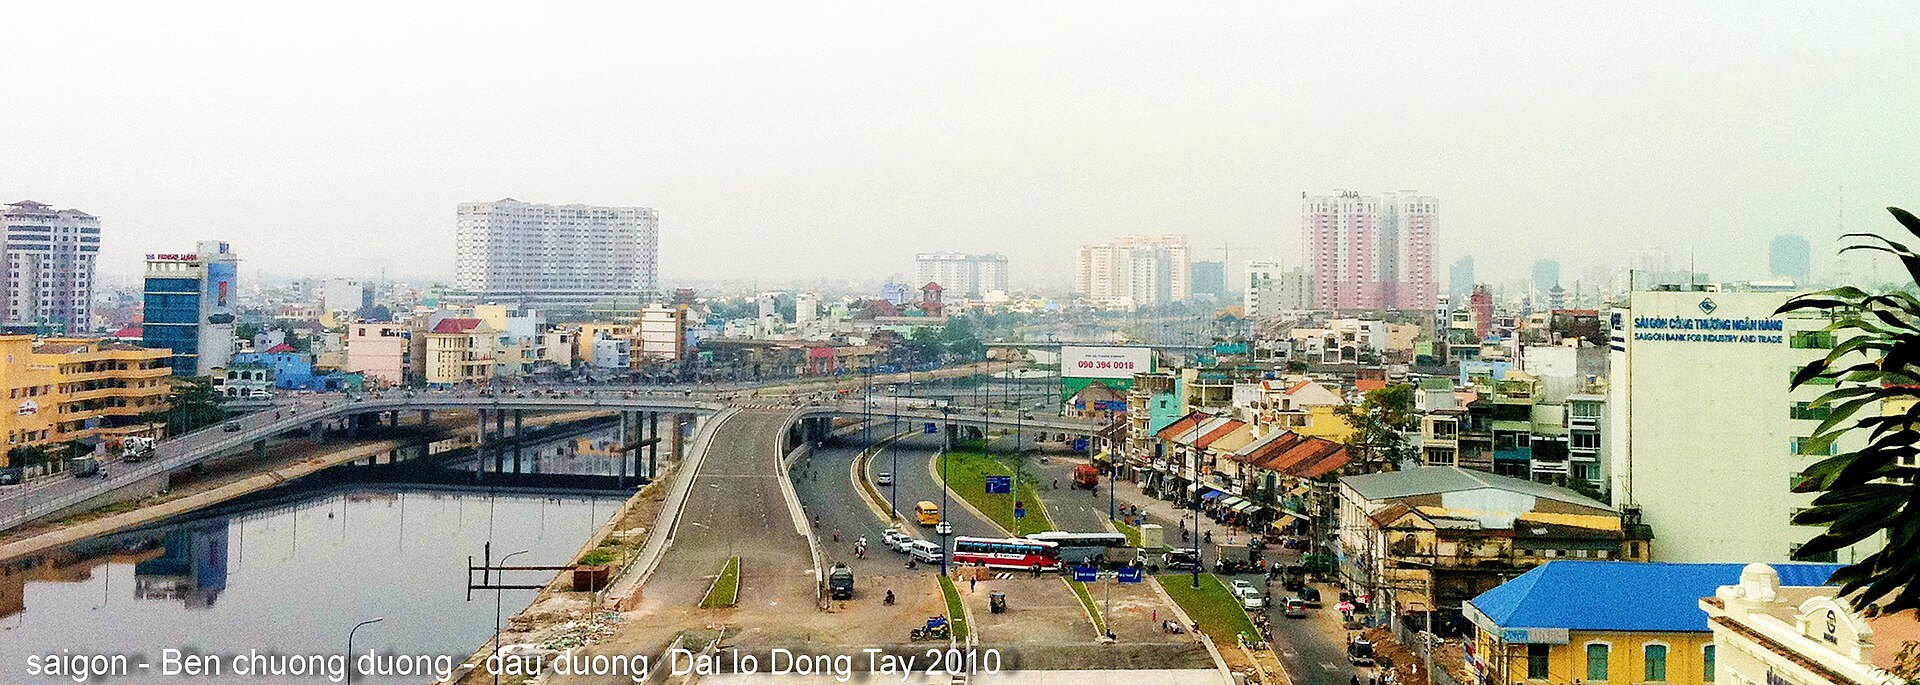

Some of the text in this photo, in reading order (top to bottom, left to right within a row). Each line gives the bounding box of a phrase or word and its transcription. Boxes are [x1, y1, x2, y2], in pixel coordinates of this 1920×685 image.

[1669, 316, 1693, 330] CÔNG
[1732, 316, 1757, 331] NGÂN
[1758, 316, 1783, 331] HÀNG
[1634, 333, 1783, 344] SAIGON BANK FOR INDUSTRY AND TRADE
[1078, 360, 1094, 369] 090
[1096, 361, 1111, 369] 394
